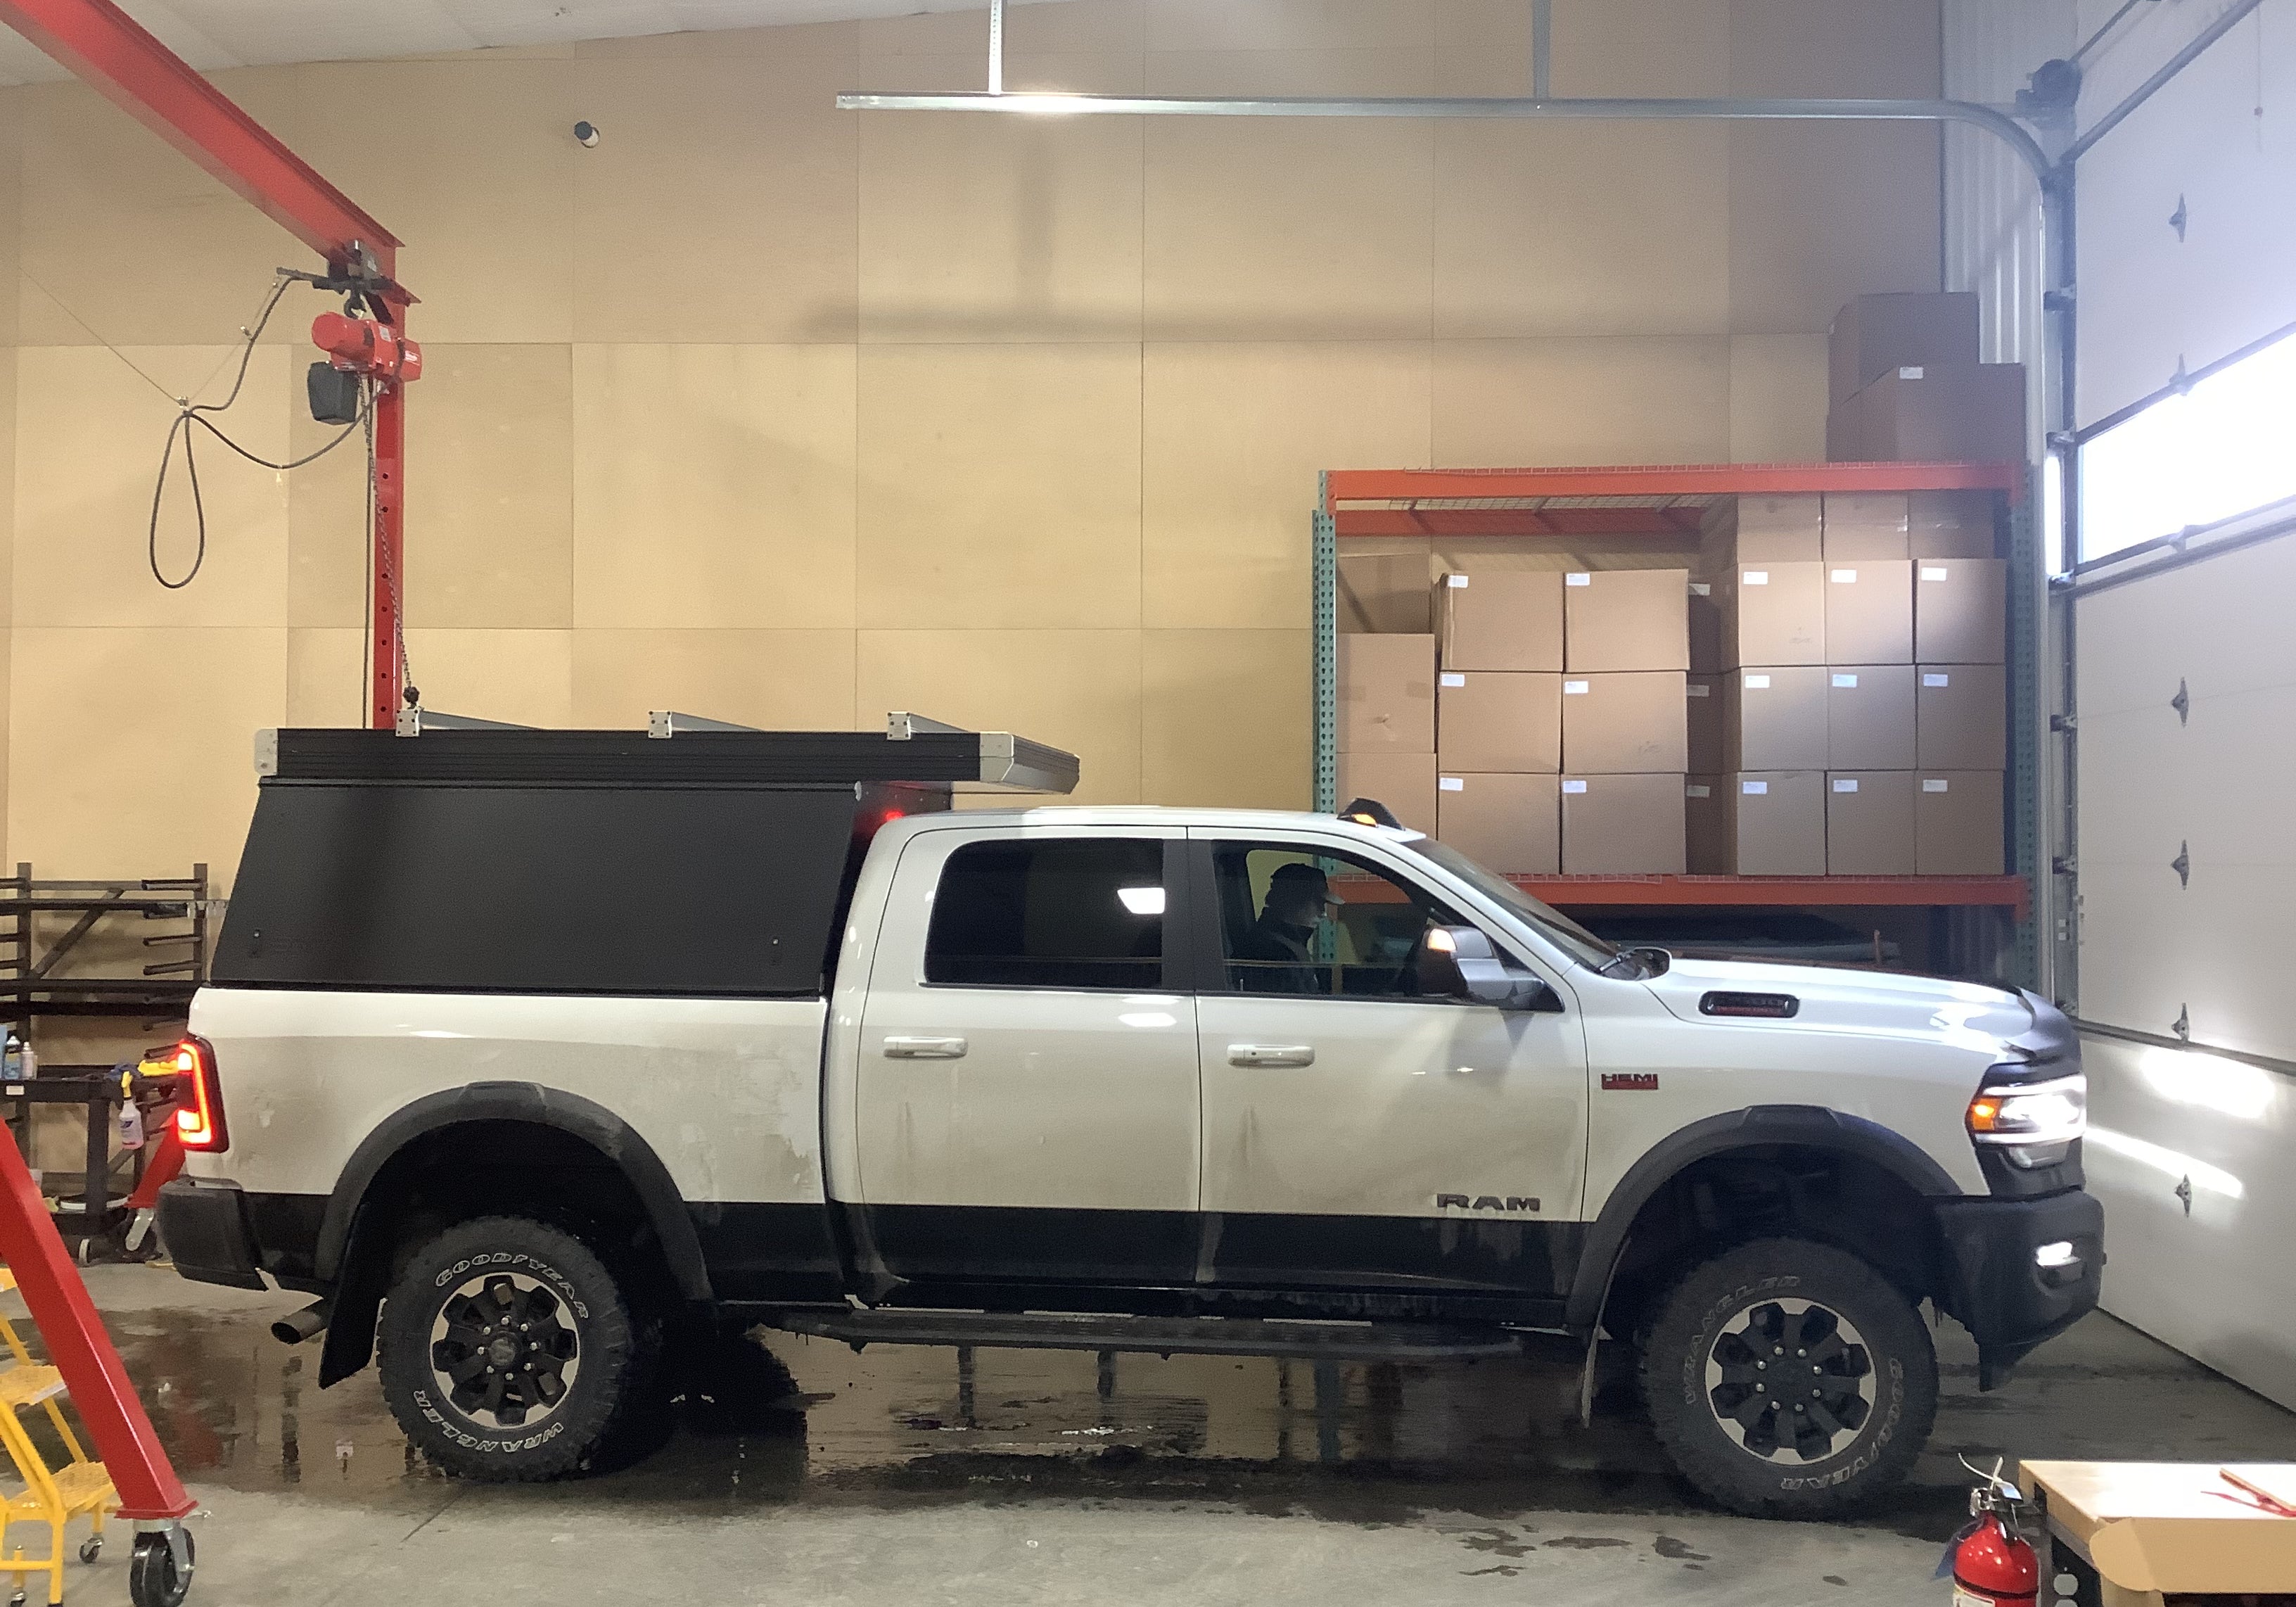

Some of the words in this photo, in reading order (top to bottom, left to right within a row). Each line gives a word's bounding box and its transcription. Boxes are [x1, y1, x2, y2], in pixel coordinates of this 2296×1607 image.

[1601, 1074, 1658, 1084] HEMI
[1437, 1193, 1541, 1212] RAM
[436, 1252, 589, 1319] GOODYEAR
[414, 1390, 563, 1452] WRANGLER
